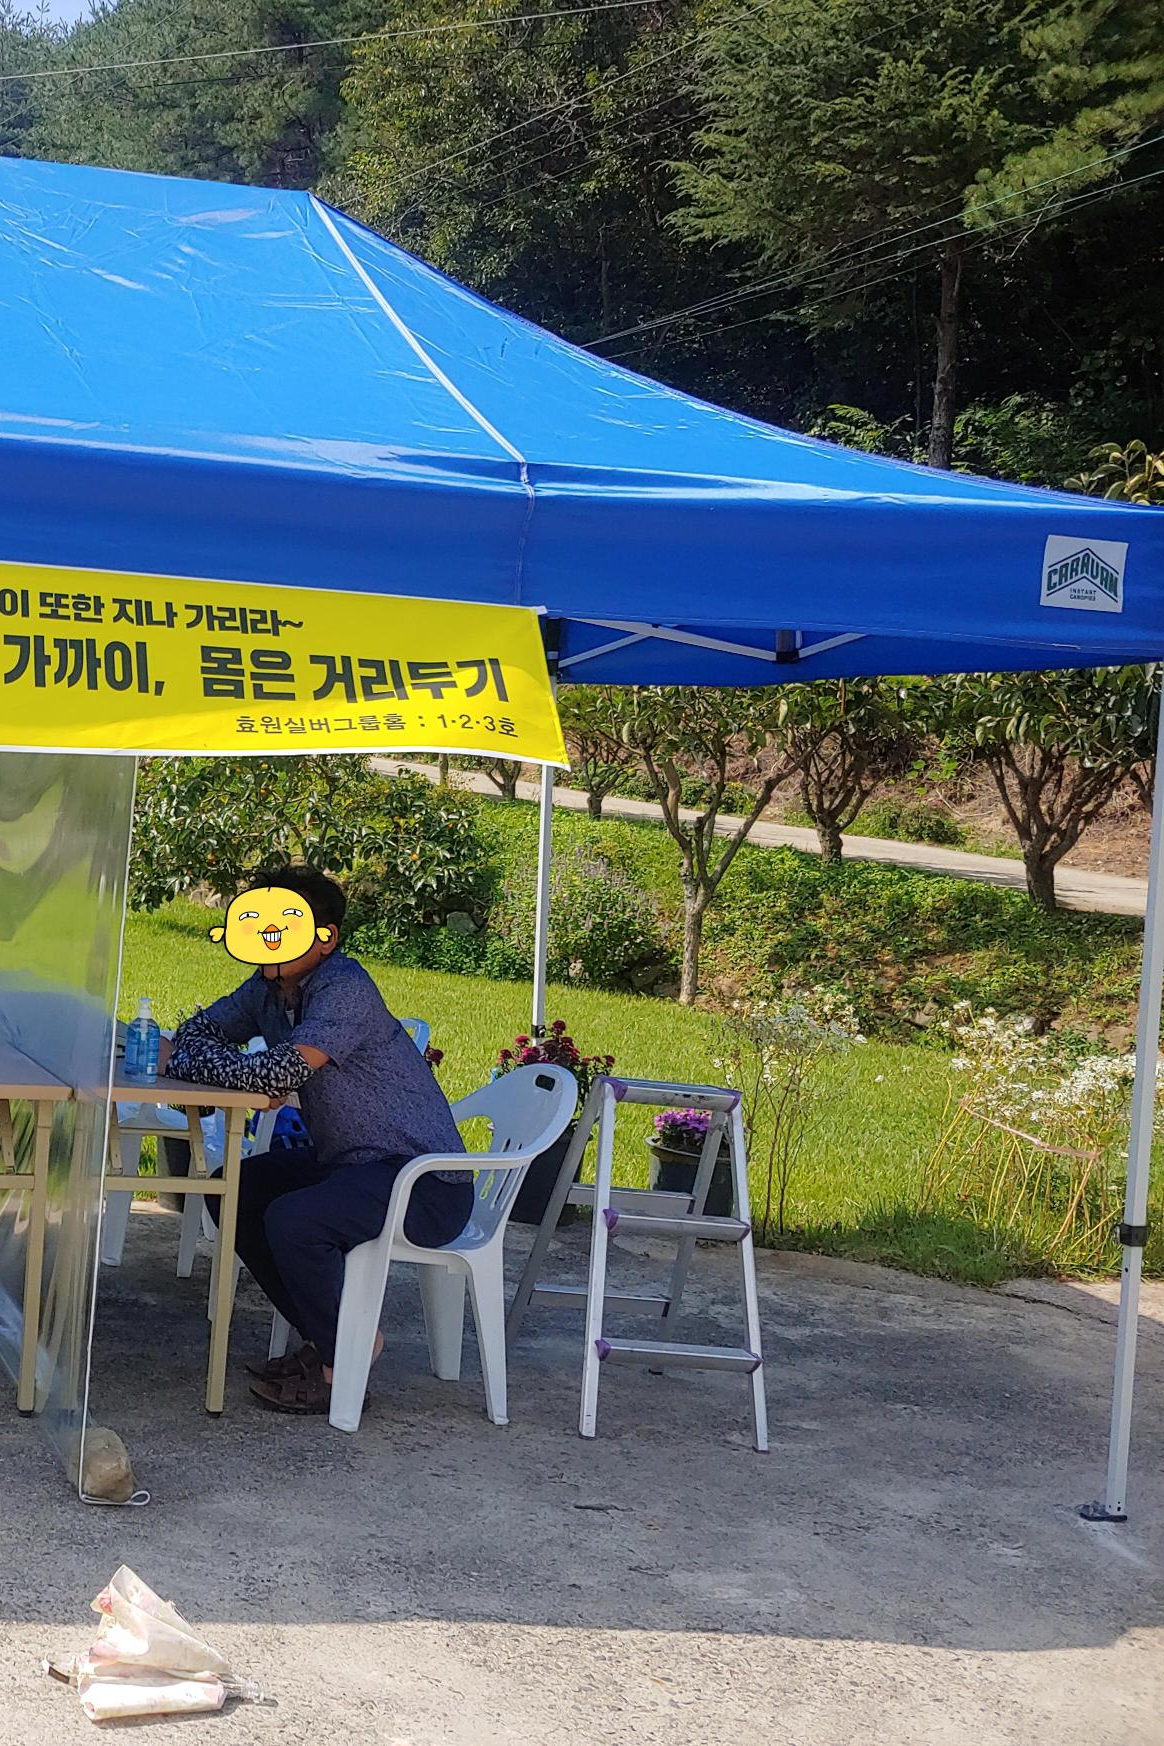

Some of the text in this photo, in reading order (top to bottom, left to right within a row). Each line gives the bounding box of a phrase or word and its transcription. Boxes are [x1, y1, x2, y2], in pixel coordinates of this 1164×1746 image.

[1047, 552, 1118, 598] CARAVAN
[39, 592, 105, 623] 또한
[112, 598, 178, 628] 지나
[185, 604, 304, 637] 가리라~
[3, 634, 165, 696] 가까이,
[200, 645, 296, 701] 몸은
[309, 655, 510, 703] 거리두기
[236, 713, 406, 734] 효원실버그룹홈
